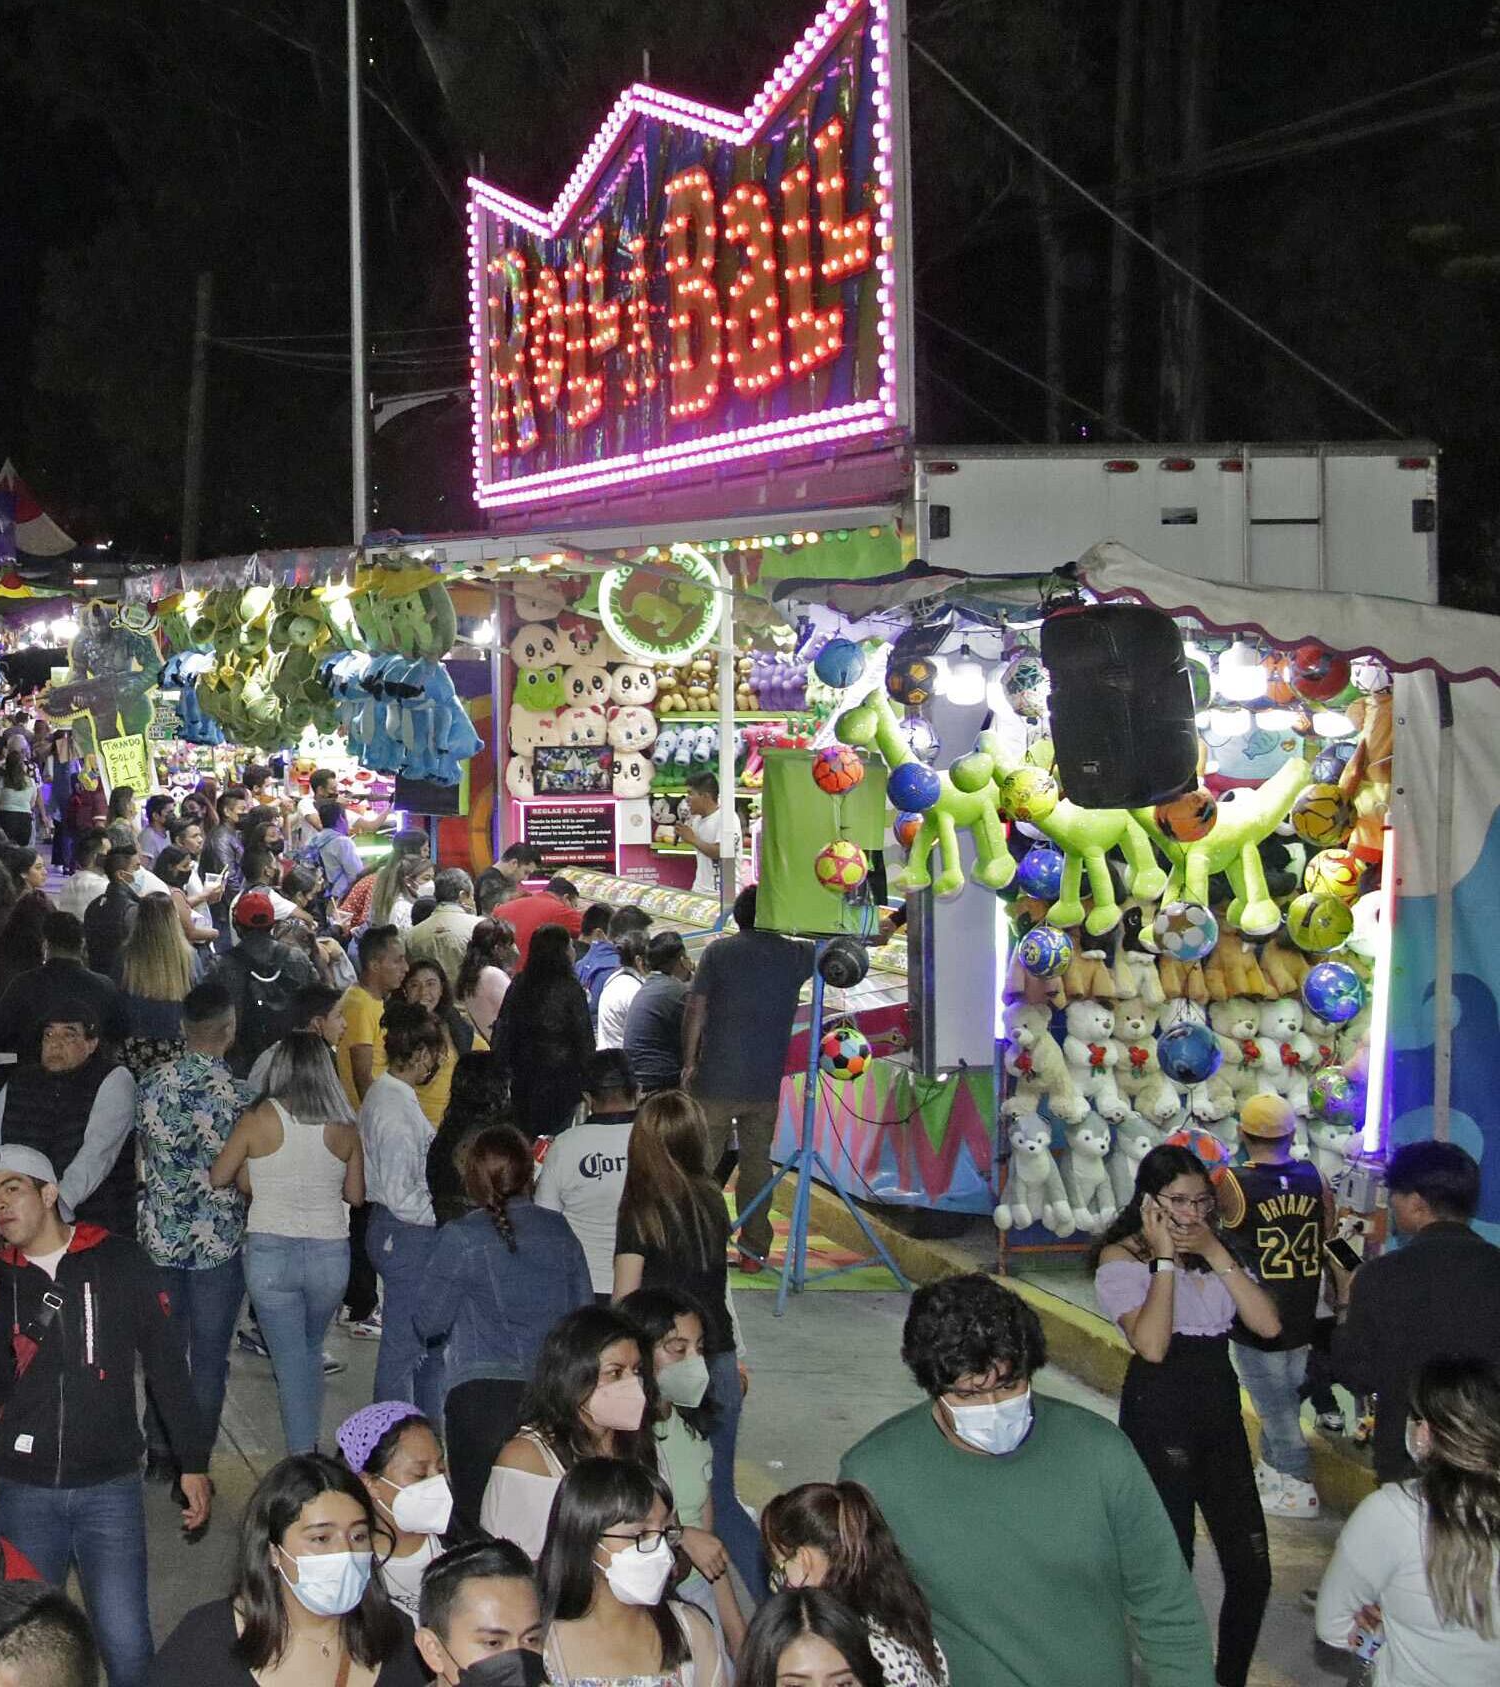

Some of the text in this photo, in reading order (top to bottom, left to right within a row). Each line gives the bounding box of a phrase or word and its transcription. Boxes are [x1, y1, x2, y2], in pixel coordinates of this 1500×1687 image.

[579, 1152, 627, 1180] Cor
[1257, 1193, 1318, 1222] BRYANT
[1256, 1221, 1320, 1279] 24
